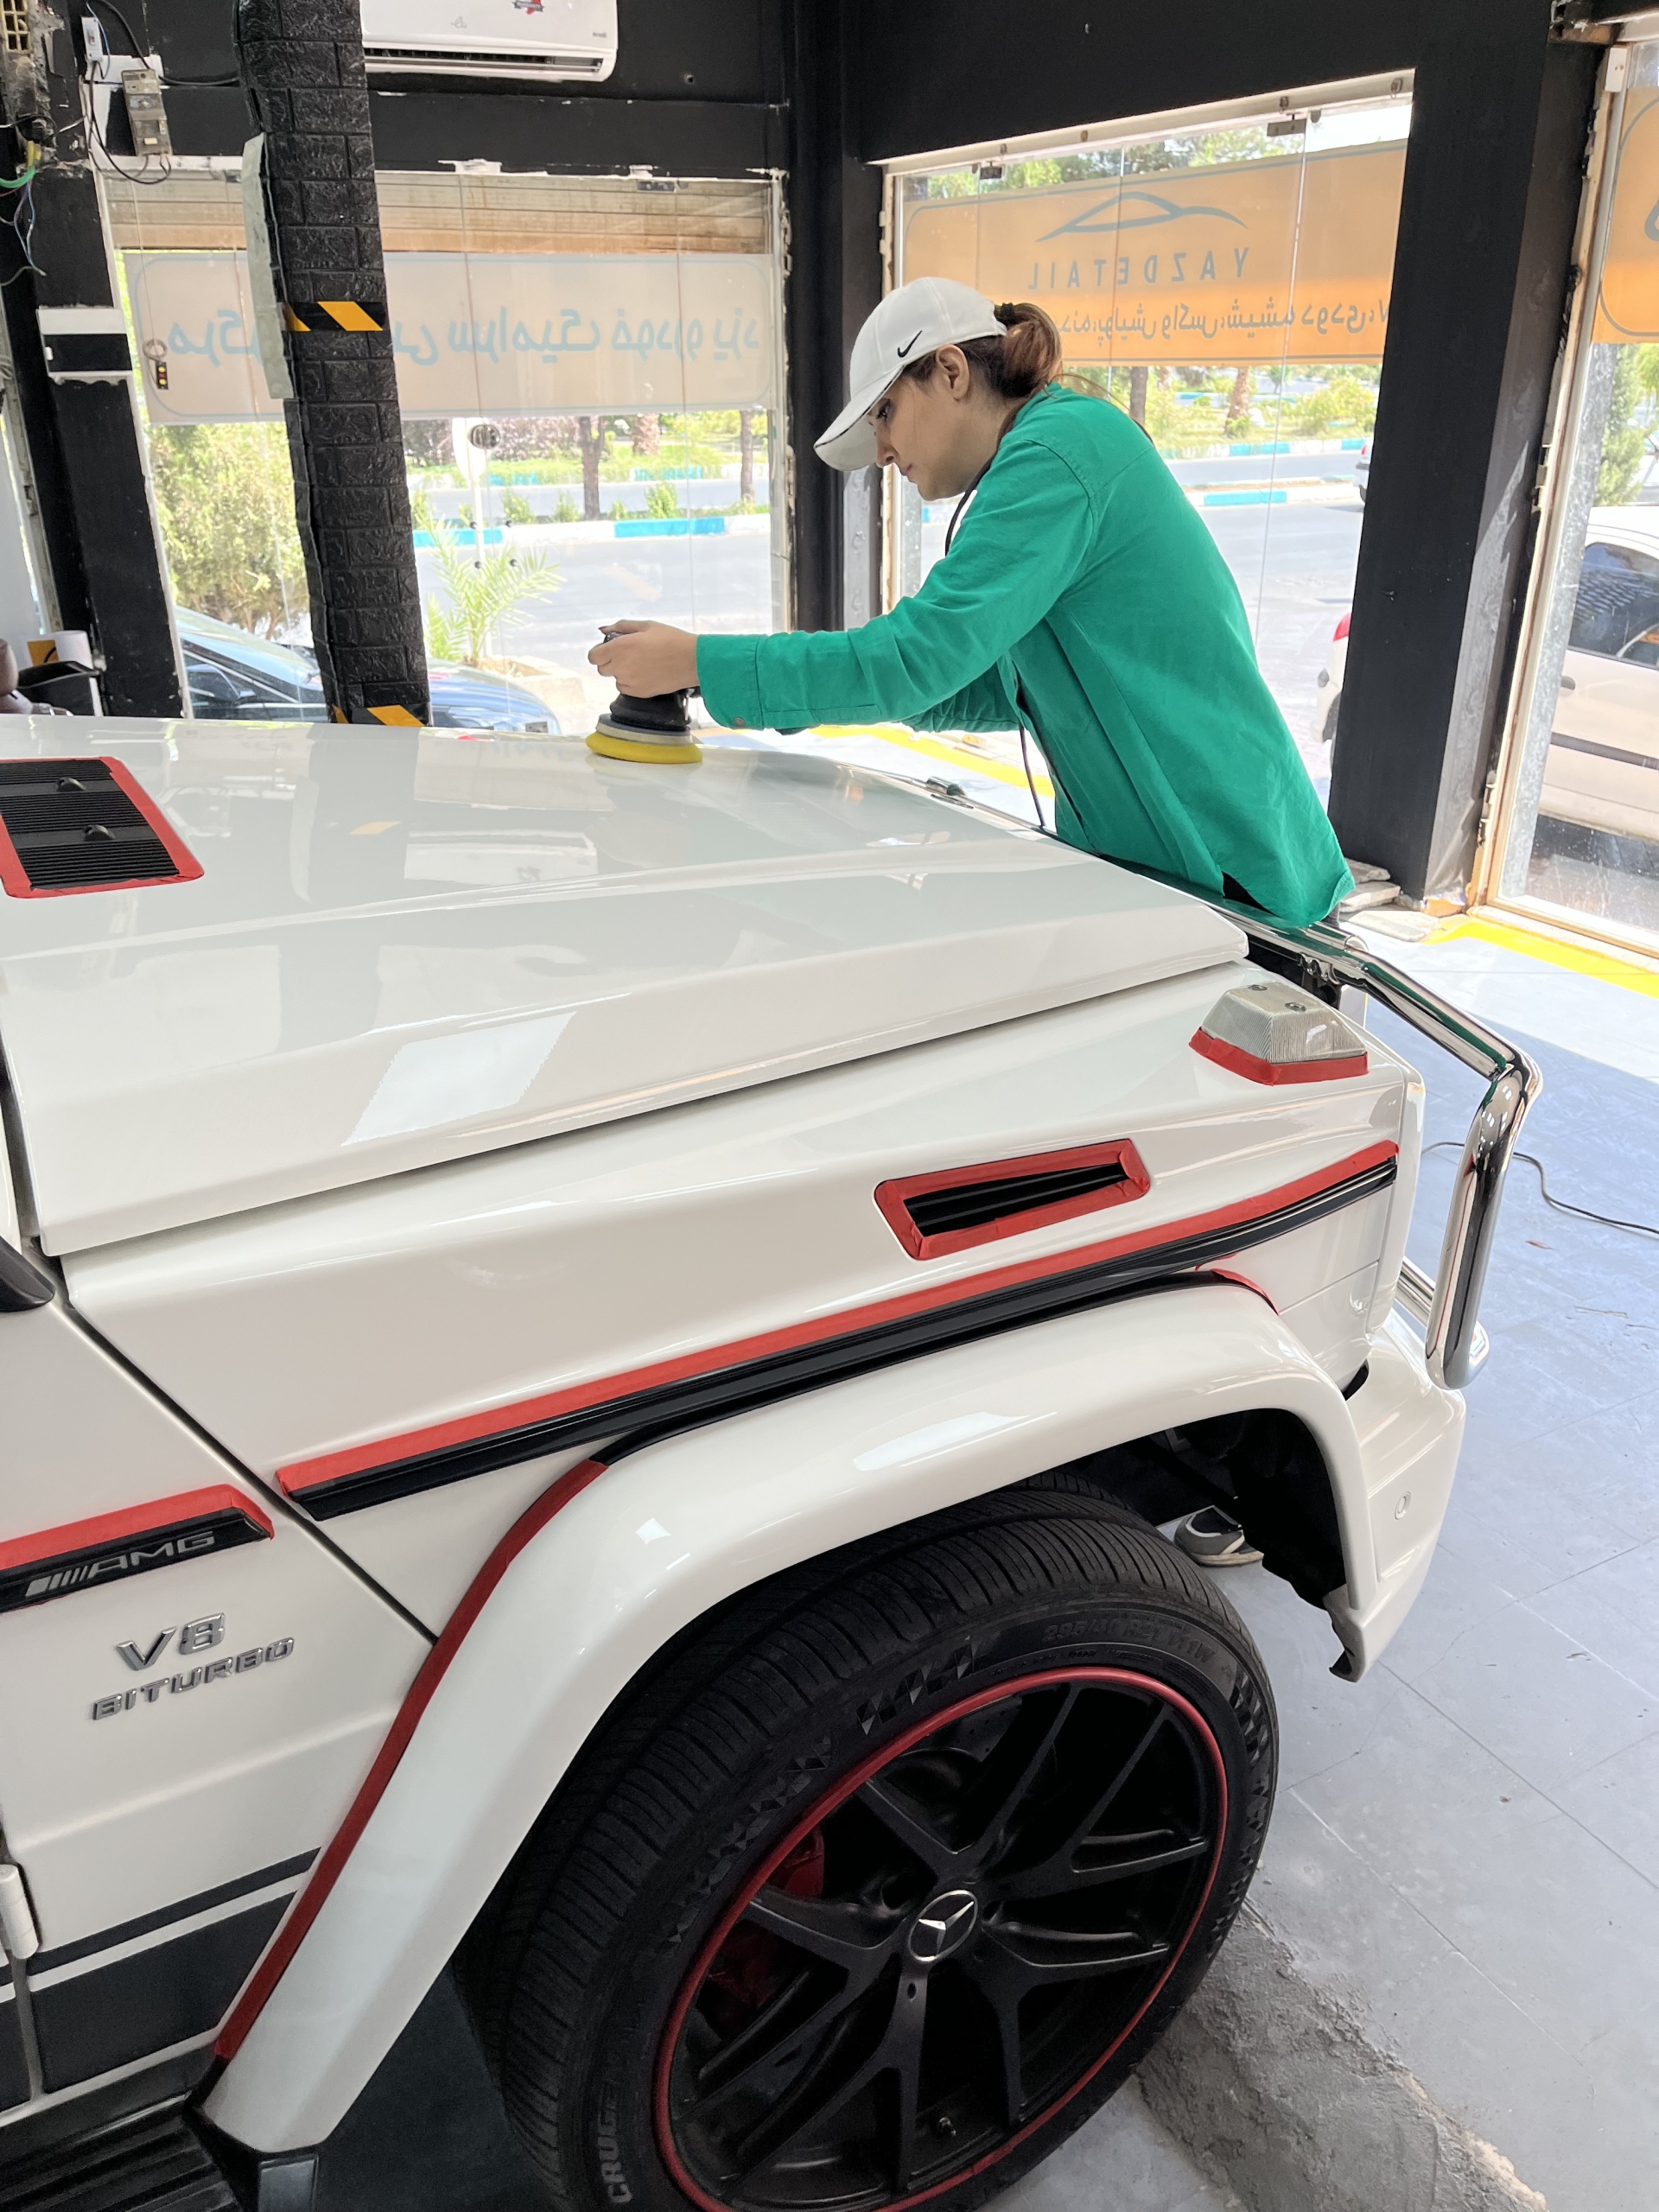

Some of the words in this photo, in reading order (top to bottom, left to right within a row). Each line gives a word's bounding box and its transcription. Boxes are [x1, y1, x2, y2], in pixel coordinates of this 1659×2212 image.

[87, 1530, 215, 1580] AMG
[116, 1612, 226, 1672] V8
[92, 1637, 296, 1721] BITURBO
